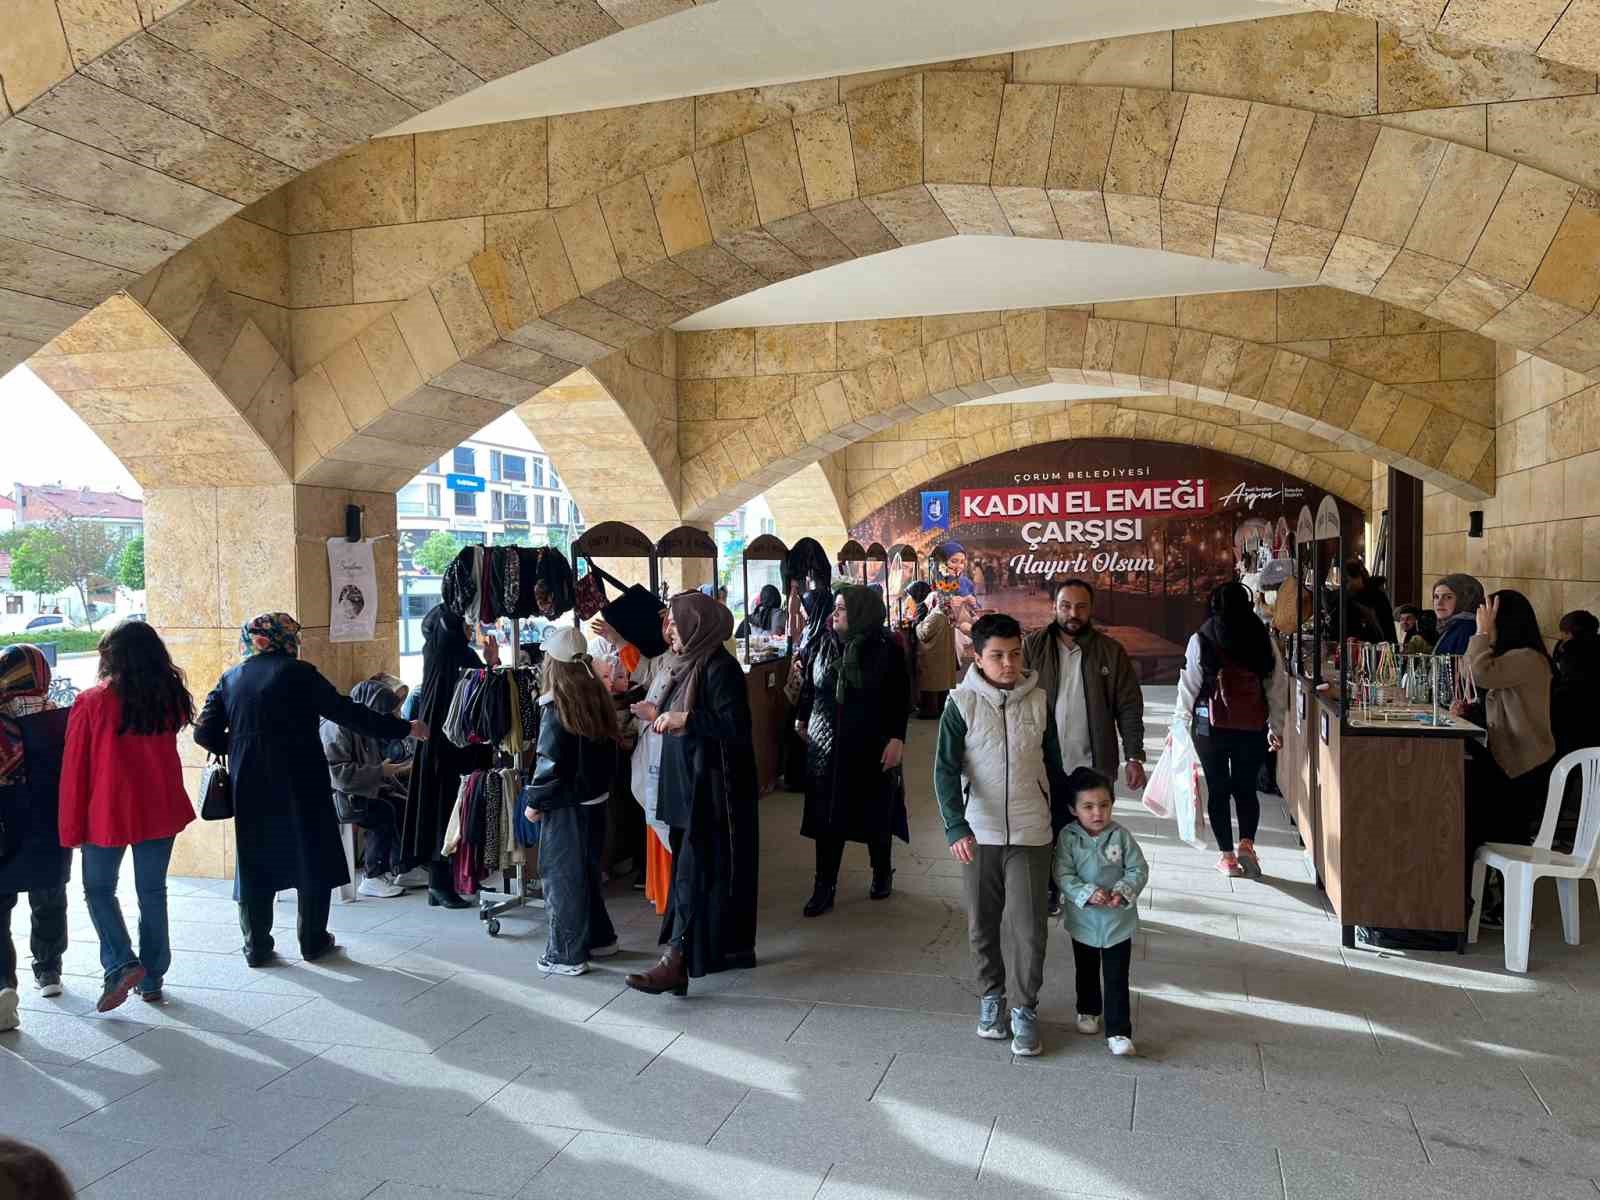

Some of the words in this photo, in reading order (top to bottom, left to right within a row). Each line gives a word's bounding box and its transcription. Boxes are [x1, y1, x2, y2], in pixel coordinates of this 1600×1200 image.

[1014, 472, 1061, 484] ÇORUM
[1068, 465, 1150, 479] BELEDİYESİ
[963, 491, 1059, 517] KADIN
[1065, 490, 1101, 513] EL
[1106, 479, 1205, 512] EMEĞİ
[1021, 518, 1142, 550] ÇARŞISI
[1009, 553, 1088, 580] Hayırlı
[1092, 552, 1154, 572] Olsun
